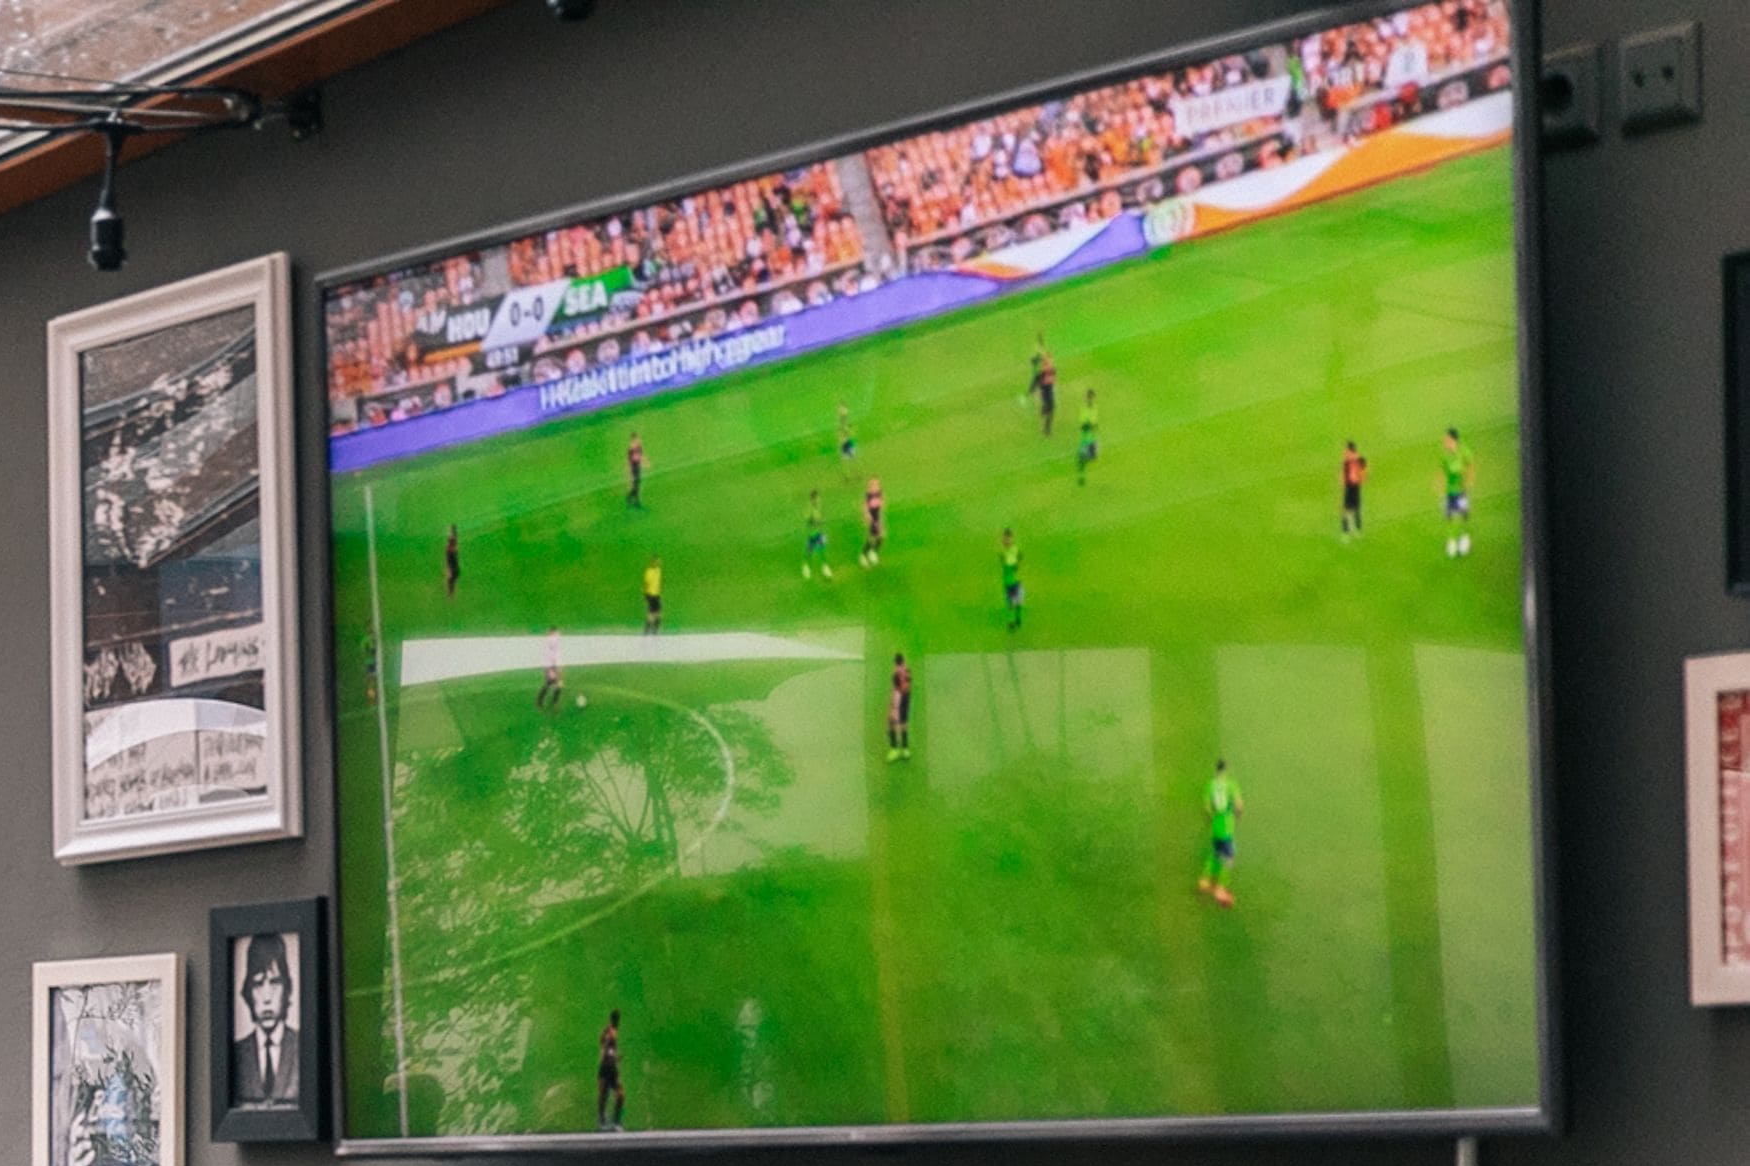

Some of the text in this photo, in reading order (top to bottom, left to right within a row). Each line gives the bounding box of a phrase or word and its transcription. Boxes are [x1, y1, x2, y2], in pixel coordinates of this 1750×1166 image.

[446, 280, 608, 343] HOU 0-0 SEA
